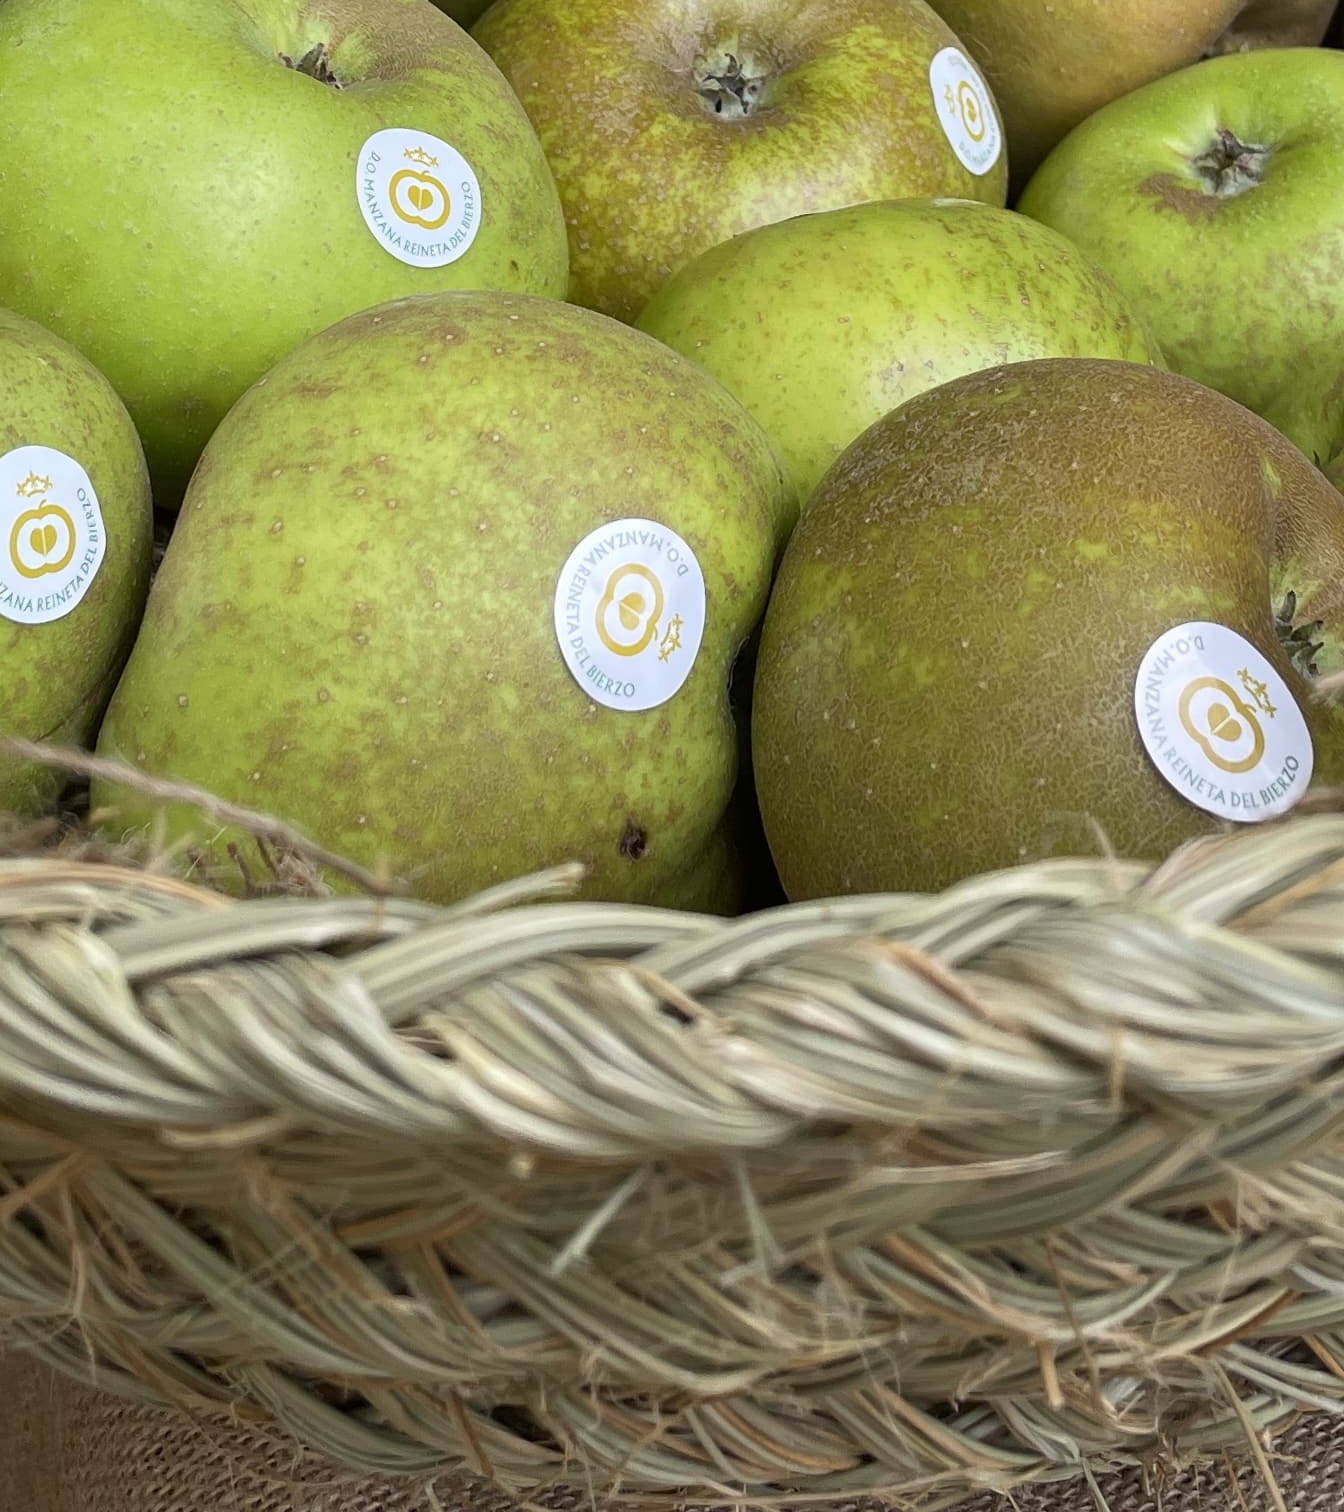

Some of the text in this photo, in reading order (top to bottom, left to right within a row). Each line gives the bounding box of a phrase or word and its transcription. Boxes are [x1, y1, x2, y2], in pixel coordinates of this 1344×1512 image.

[364, 178, 401, 248] MANZANA
[403, 239, 452, 257] REINETA
[450, 228, 467, 249] DEL
[461, 181, 474, 229] BIERZO
[76, 488, 99, 543] BIERZO
[36, 574, 84, 612] REINETA
[80, 548, 97, 575] DEL
[566, 530, 689, 698] D.O. MANZANA REINETA DEL BIERZO
[1144, 635, 1300, 809] D.O. MANZANA REINETA DEL BIERZO
